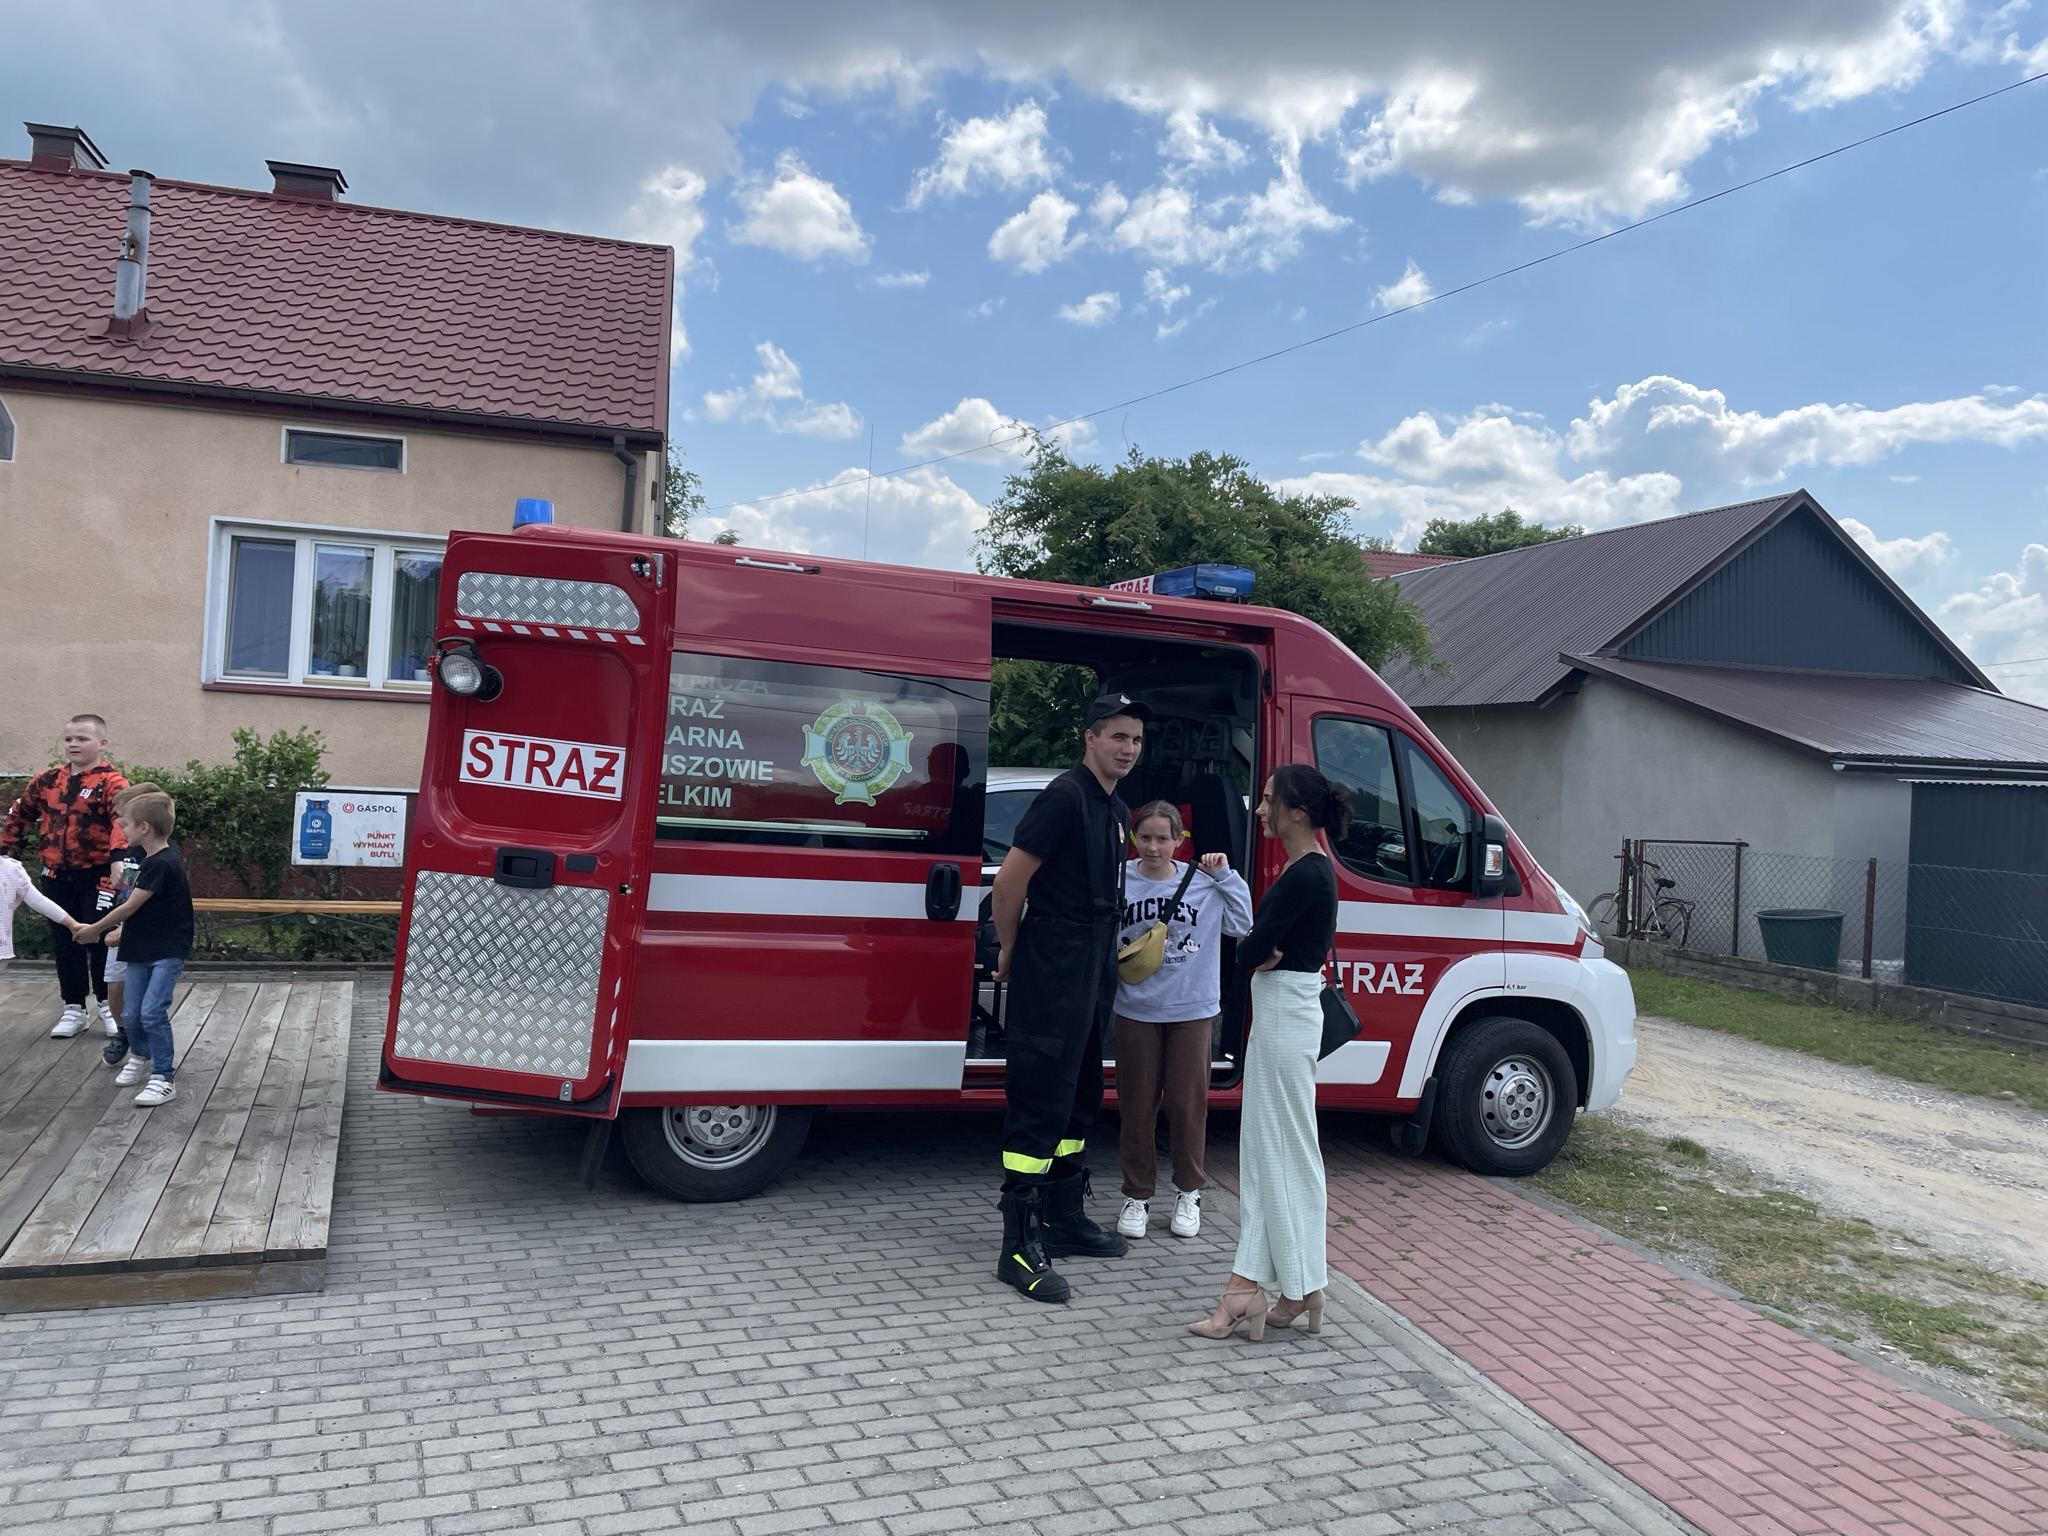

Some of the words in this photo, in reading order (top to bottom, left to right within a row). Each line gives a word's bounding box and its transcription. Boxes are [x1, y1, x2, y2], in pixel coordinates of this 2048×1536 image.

[670, 694, 725, 719] RAŻ
[664, 725, 744, 750] ARNA
[357, 804, 398, 813] GASPOL
[353, 841, 395, 849] WYMIANY
